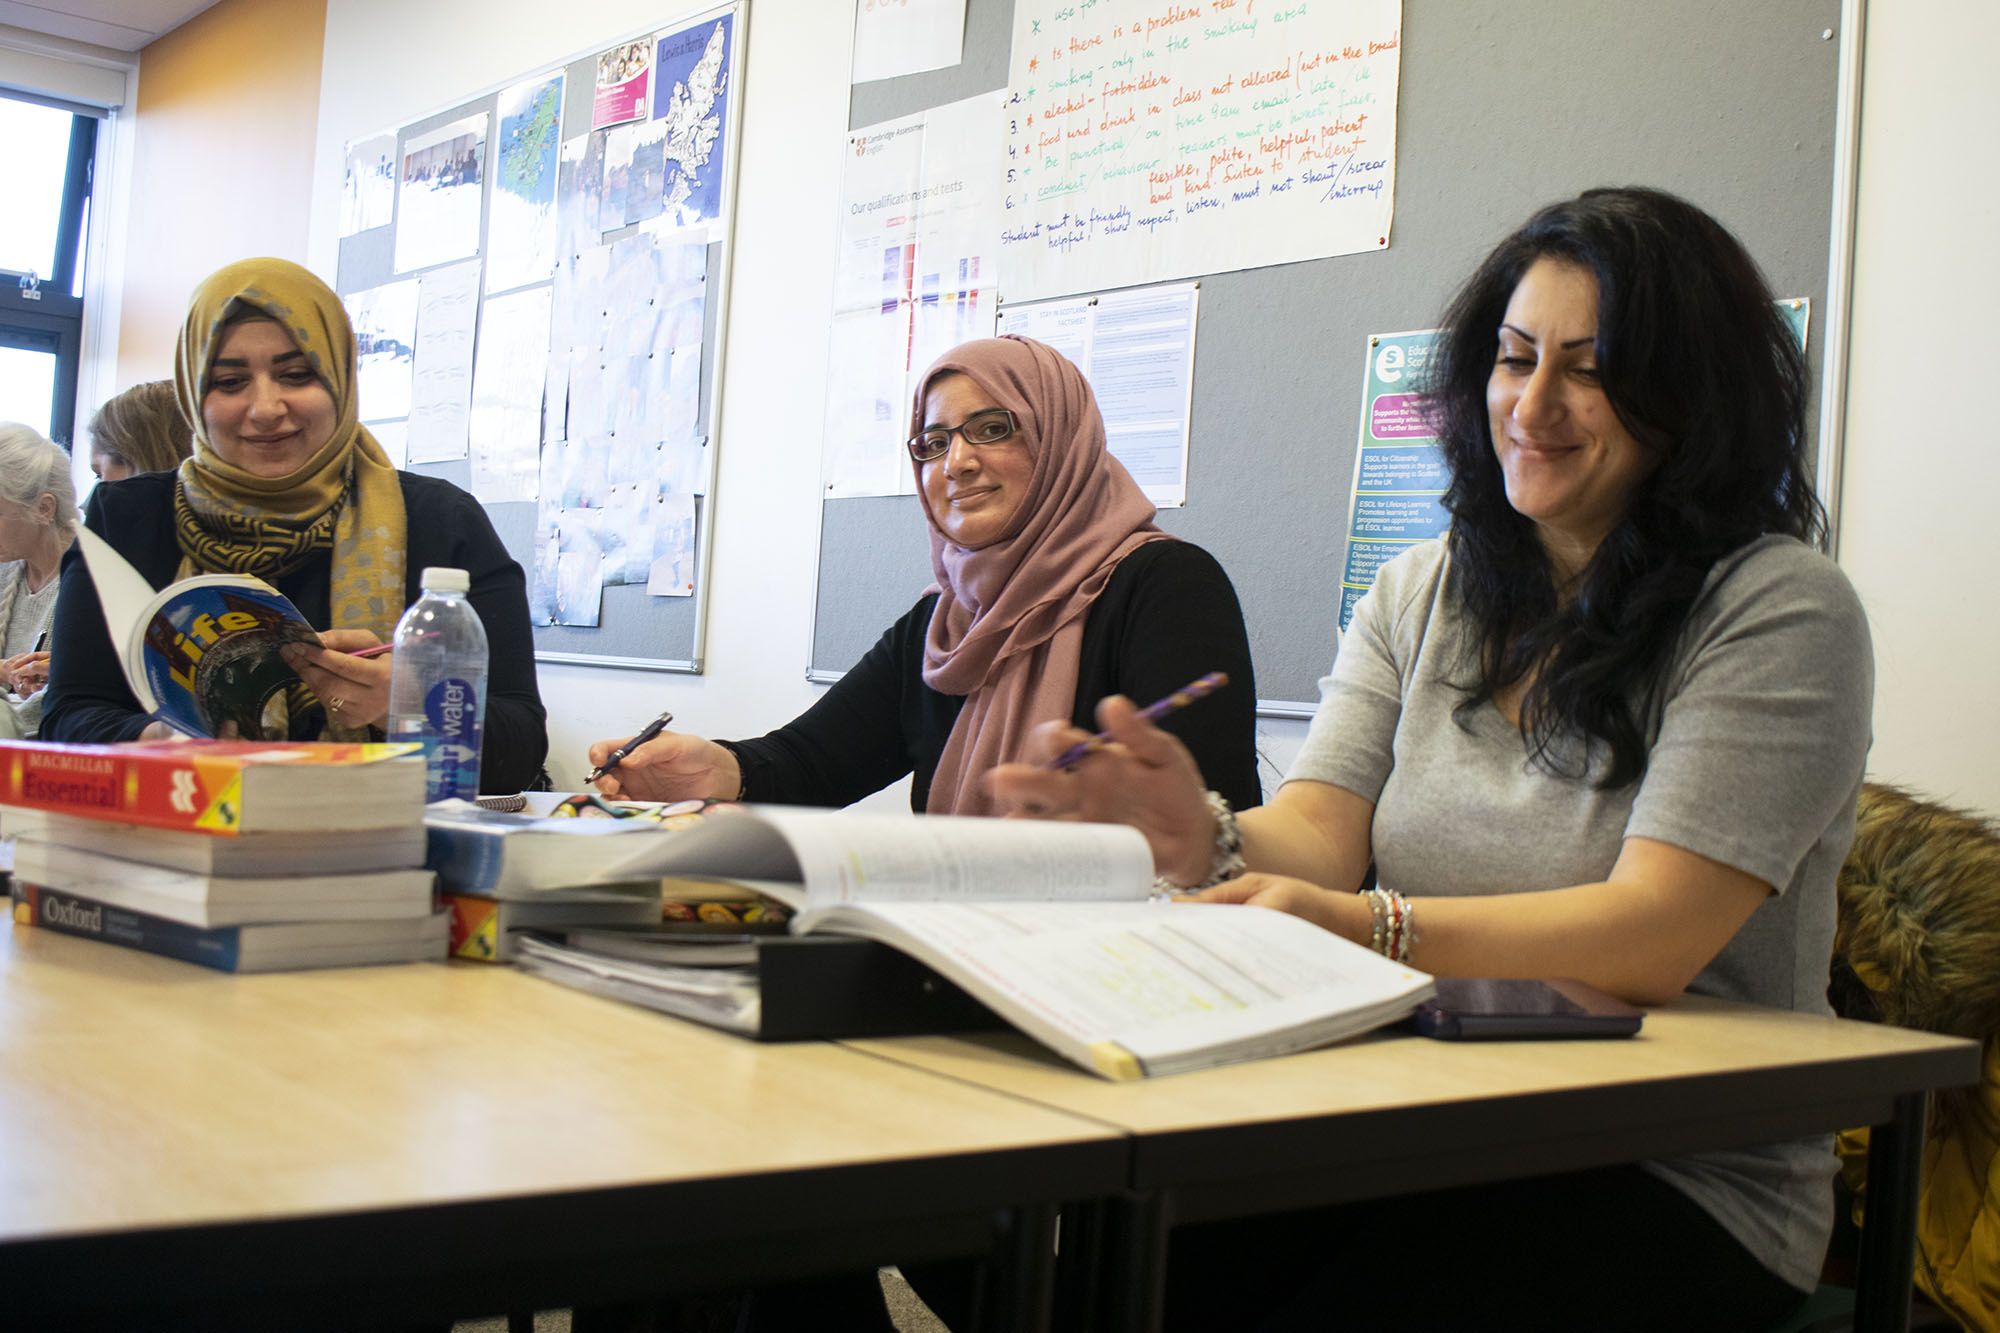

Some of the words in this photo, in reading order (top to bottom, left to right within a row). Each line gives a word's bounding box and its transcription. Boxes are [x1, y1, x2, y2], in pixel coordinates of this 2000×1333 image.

[1054, 7, 1075, 21] use
[1068, 35, 1103, 55] there
[1112, 24, 1123, 40] is
[1131, 21, 1142, 34] a
[1146, 5, 1201, 43] problem
[1048, 67, 1094, 93] smoking
[1111, 51, 1134, 74] only
[1142, 48, 1155, 59] in
[1165, 34, 1191, 54] the
[1203, 17, 1259, 41] smoking
[1273, 3, 1308, 24] area
[1038, 127, 1062, 161] food
[1099, 106, 1136, 132] drink
[1147, 103, 1161, 116] in
[1172, 73, 1203, 108] class
[1211, 72, 1235, 96] not
[1240, 55, 1292, 90] allowed
[1325, 50, 1341, 65] in
[1342, 46, 1364, 60] the
[1101, 72, 1172, 111] forbidden
[1252, 86, 1291, 112] email
[867, 130, 896, 145] Cambridge
[1235, 122, 1265, 139] must
[1268, 118, 1283, 133] be
[1320, 113, 1369, 149] patient
[1149, 182, 1174, 205] and
[1270, 157, 1284, 173] to
[1297, 136, 1367, 167] student
[850, 201, 866, 216] Our
[866, 189, 922, 215] qualifications
[921, 185, 940, 200] and
[940, 180, 964, 196] tests
[1103, 221, 1130, 236] show
[1231, 179, 1262, 203] must
[1269, 177, 1295, 197] not
[1000, 223, 1043, 245] Student
[1045, 212, 1070, 232] must
[1074, 213, 1087, 229] be
[1089, 204, 1132, 233] friendly
[1353, 544, 1372, 552] ESOL
[170, 611, 260, 695] Life
[440, 679, 465, 738] water
[28, 752, 115, 776] MACMILLAN
[22, 772, 118, 810] Essential
[42, 894, 102, 933] Oxford
